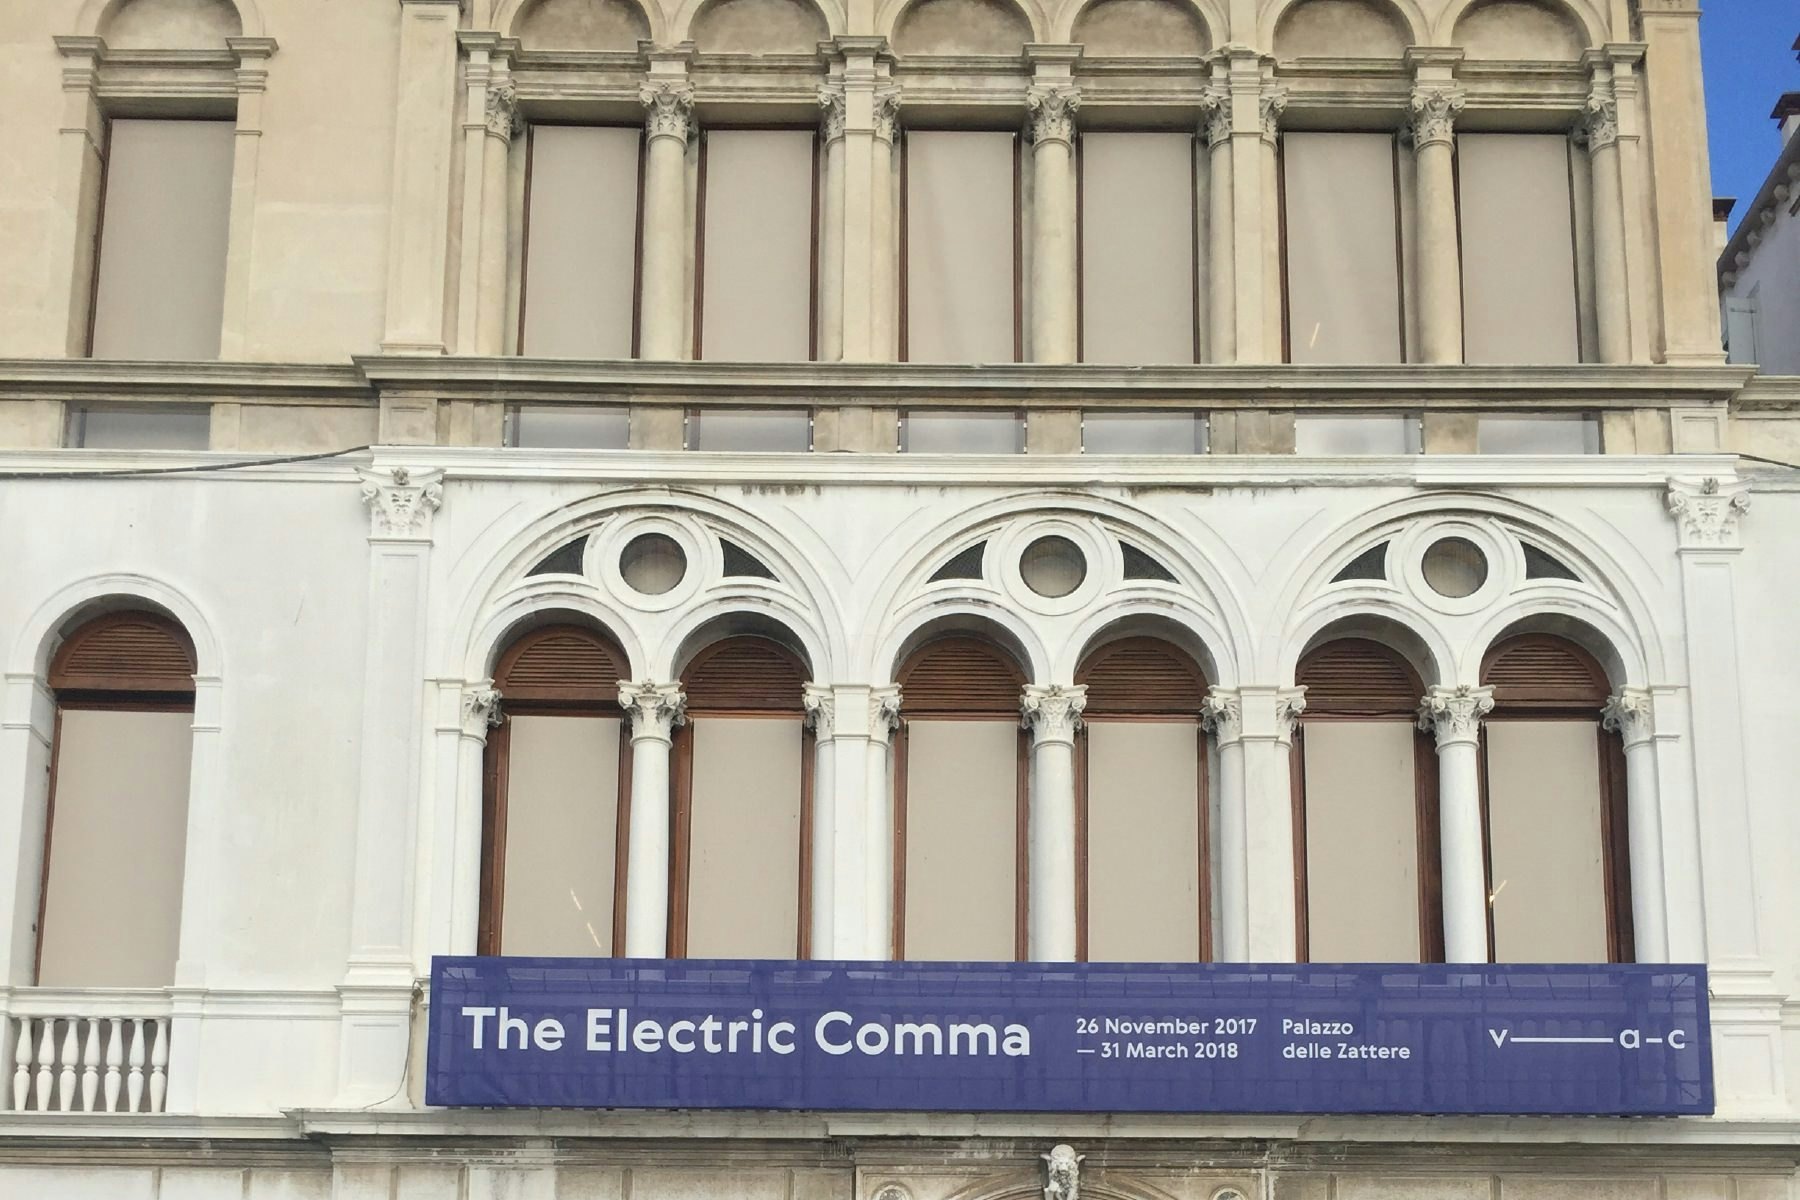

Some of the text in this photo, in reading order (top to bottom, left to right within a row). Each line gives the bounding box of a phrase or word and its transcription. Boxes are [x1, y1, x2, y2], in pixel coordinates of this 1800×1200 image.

[462, 1006, 1030, 1056] The Electric Comma
[1076, 1018, 1257, 1035] 26 November 2017
[1282, 1018, 1353, 1035] Palazzo
[1101, 1042, 1119, 1058] 31
[1126, 1042, 1189, 1058] March
[1194, 1042, 1238, 1059] 2018
[1282, 1042, 1411, 1060] delle Zattere
